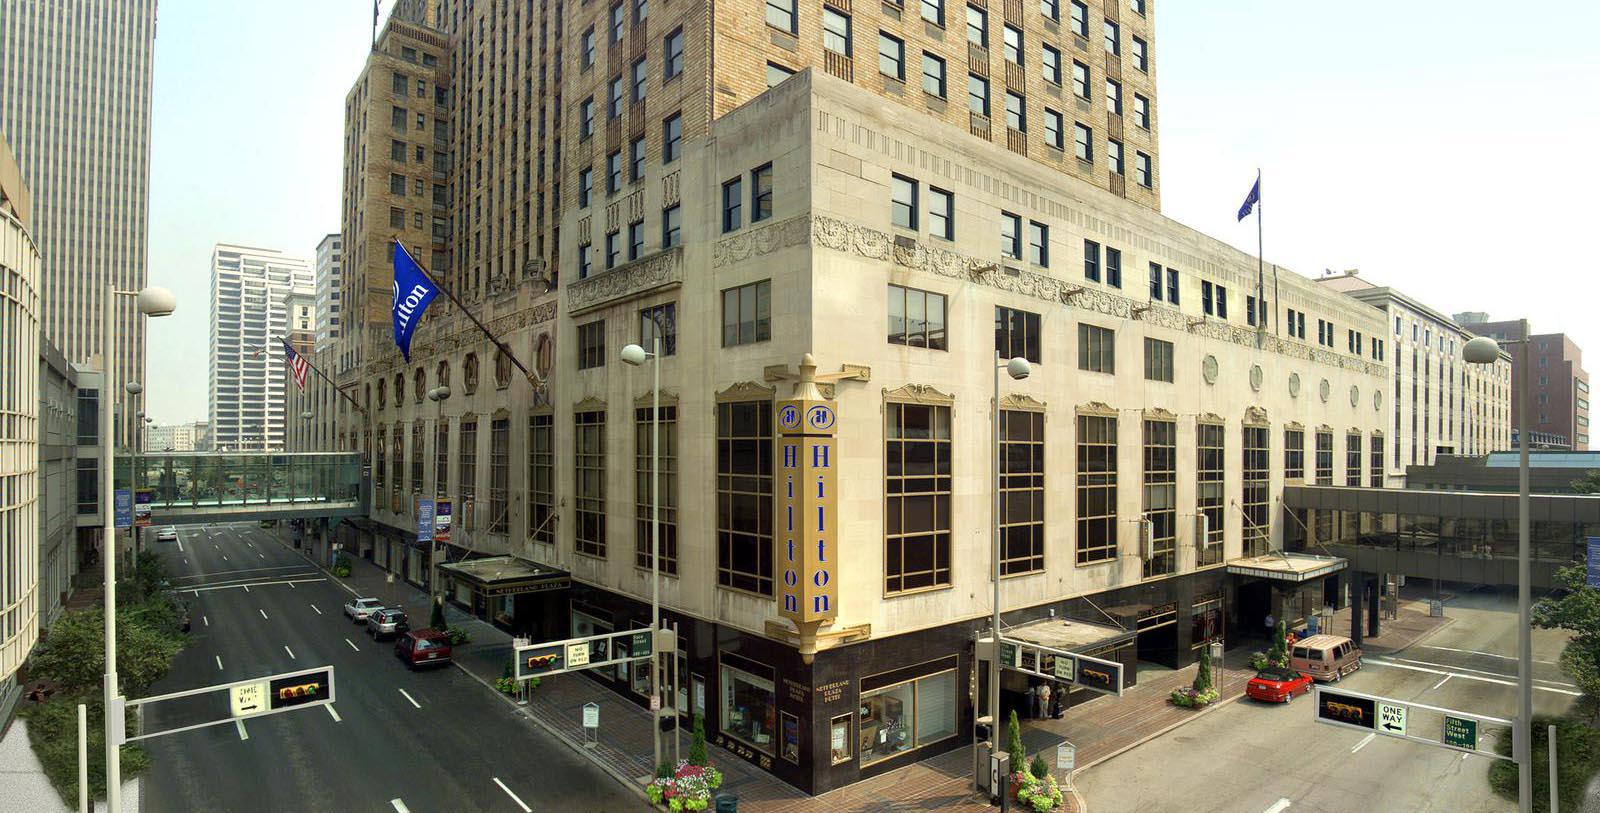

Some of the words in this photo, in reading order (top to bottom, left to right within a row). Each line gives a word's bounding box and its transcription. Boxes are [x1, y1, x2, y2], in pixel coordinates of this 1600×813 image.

[398, 284, 429, 336] lton
[783, 445, 798, 613] Hilton
[812, 445, 831, 614] Hilton
[1383, 706, 1402, 716] ONE
[1382, 713, 1403, 723] WAY
[1446, 718, 1462, 727] Fifth
[1446, 724, 1469, 735] Street
[1446, 731, 1466, 740] West
